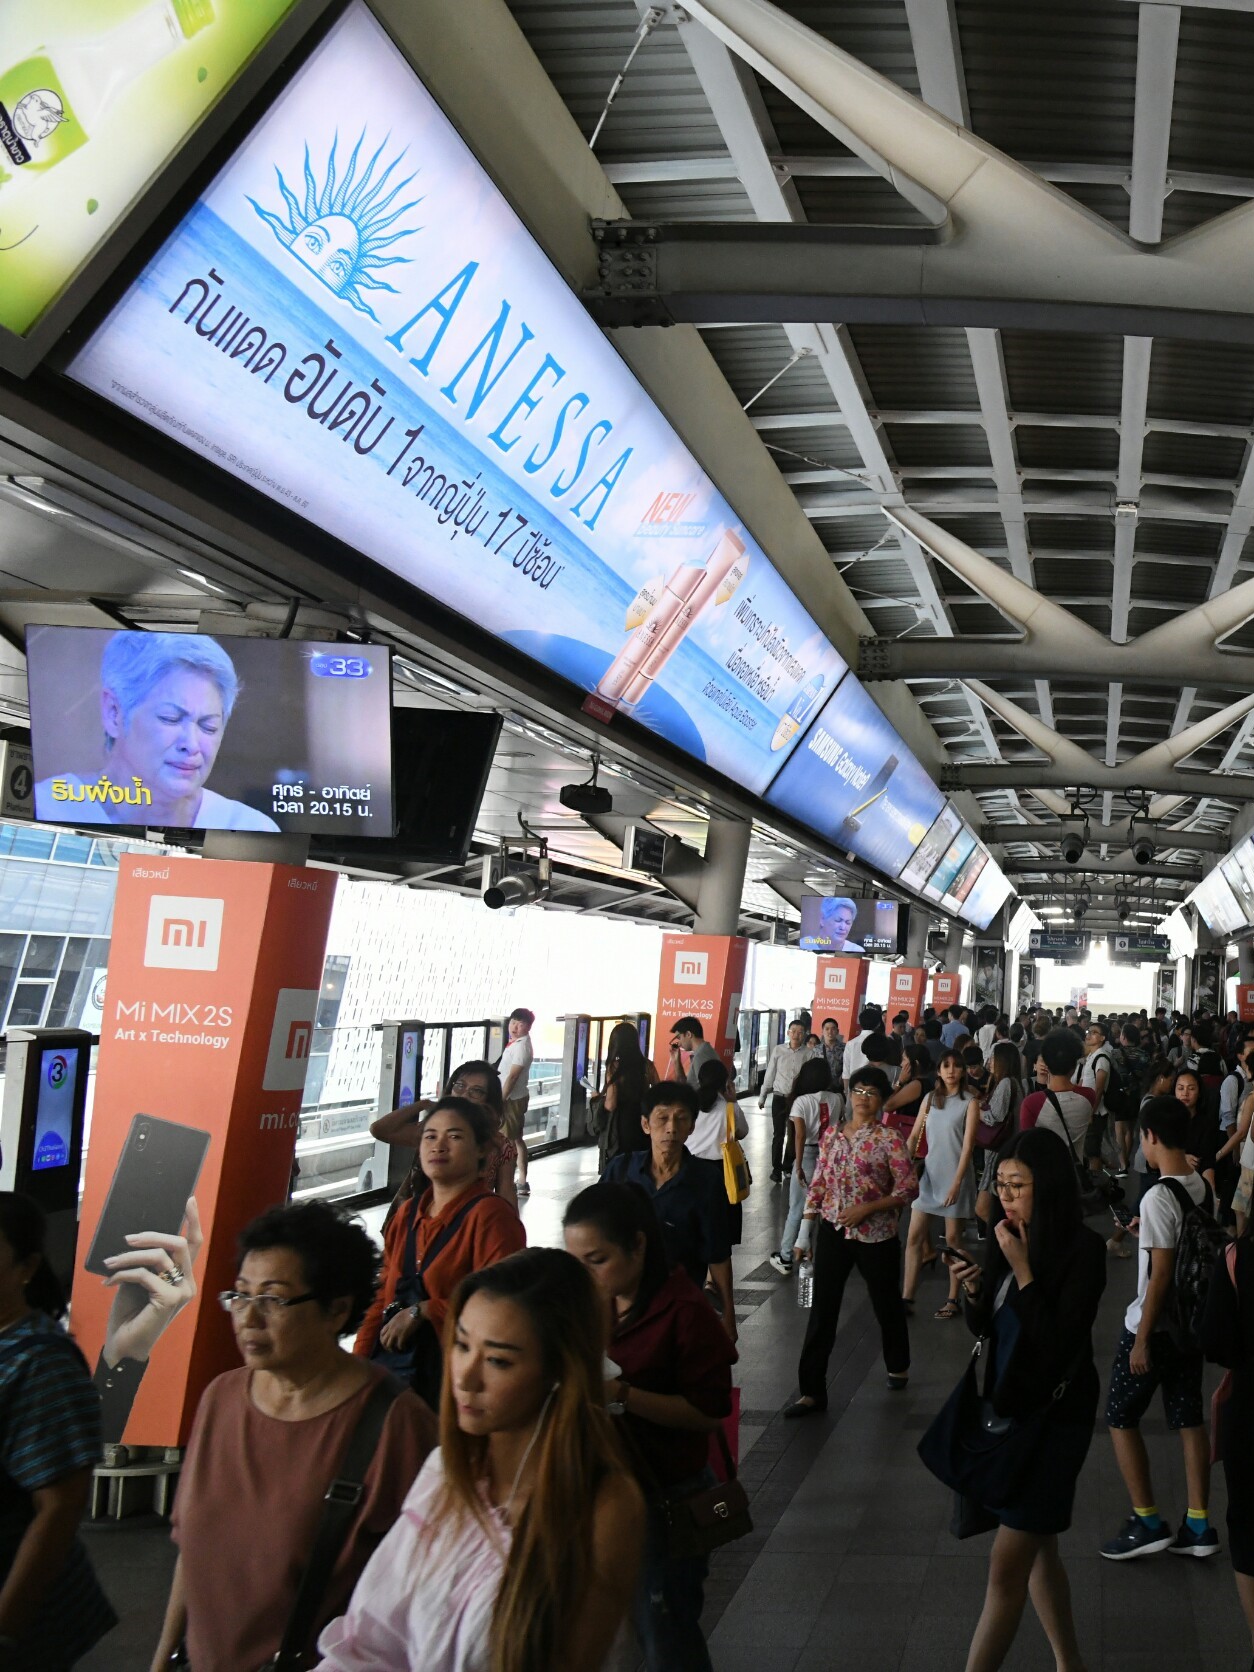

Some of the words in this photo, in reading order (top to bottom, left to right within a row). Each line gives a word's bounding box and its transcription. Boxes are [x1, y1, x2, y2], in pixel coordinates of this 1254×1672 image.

[384, 261, 634, 531] ANESSA
[169, 268, 287, 384] กันแดด
[283, 339, 396, 455] อันดับ
[486, 508, 528, 556] 17
[329, 658, 364, 677] 33
[14, 769, 27, 797] 4
[51, 776, 152, 806] ริมฝั่งน้ำ
[272, 781, 303, 804] ศุกร์
[321, 783, 371, 802] อาทิตย์
[273, 800, 303, 815] เวลา
[310, 800, 352, 816] 20.15
[357, 803, 374, 817] น.
[116, 1000, 146, 1021] Mi
[151, 1002, 200, 1024] MIX
[203, 1005, 233, 1027] 2S
[662, 998, 675, 1008] Mi
[677, 998, 699, 1009] MIX
[701, 1000, 713, 1010] 2S
[678, 1011, 713, 1019] Technology
[114, 1028, 136, 1041] Art
[138, 1032, 147, 1041] x
[151, 1030, 230, 1049] Technology
